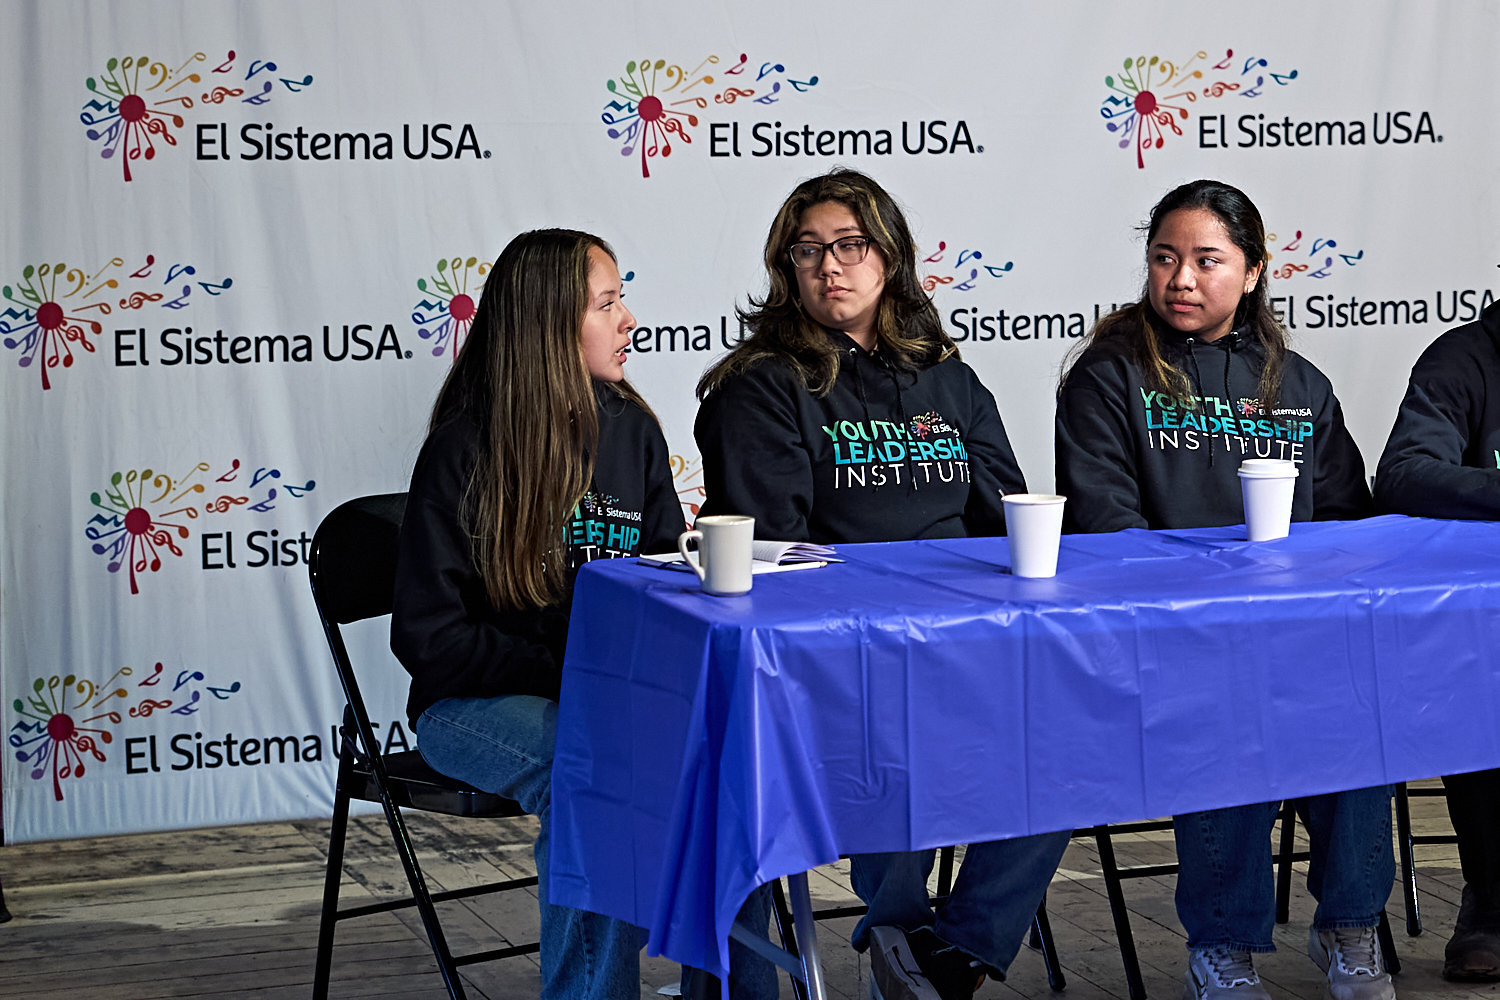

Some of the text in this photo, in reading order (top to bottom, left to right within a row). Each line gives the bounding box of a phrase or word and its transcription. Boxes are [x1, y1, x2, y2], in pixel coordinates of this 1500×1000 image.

[196, 122, 231, 161] El
[240, 122, 393, 161] Sistema
[710, 121, 742, 157] El
[751, 121, 892, 157] Sistema
[1199, 114, 1229, 149] El
[1237, 113, 1366, 148] Sistema
[949, 306, 1085, 342] Sistema
[1305, 294, 1429, 329] Sistema
[114, 327, 150, 367] El
[160, 326, 313, 366] Sistema
[1139, 387, 1234, 417] YOUTH
[821, 420, 914, 442] YOUTH
[1145, 409, 1314, 442] LEADERSHIP
[833, 436, 968, 465] LEADERSHI
[201, 528, 312, 570] El Sist
[124, 734, 161, 775] El
[170, 731, 323, 772] Sistema
